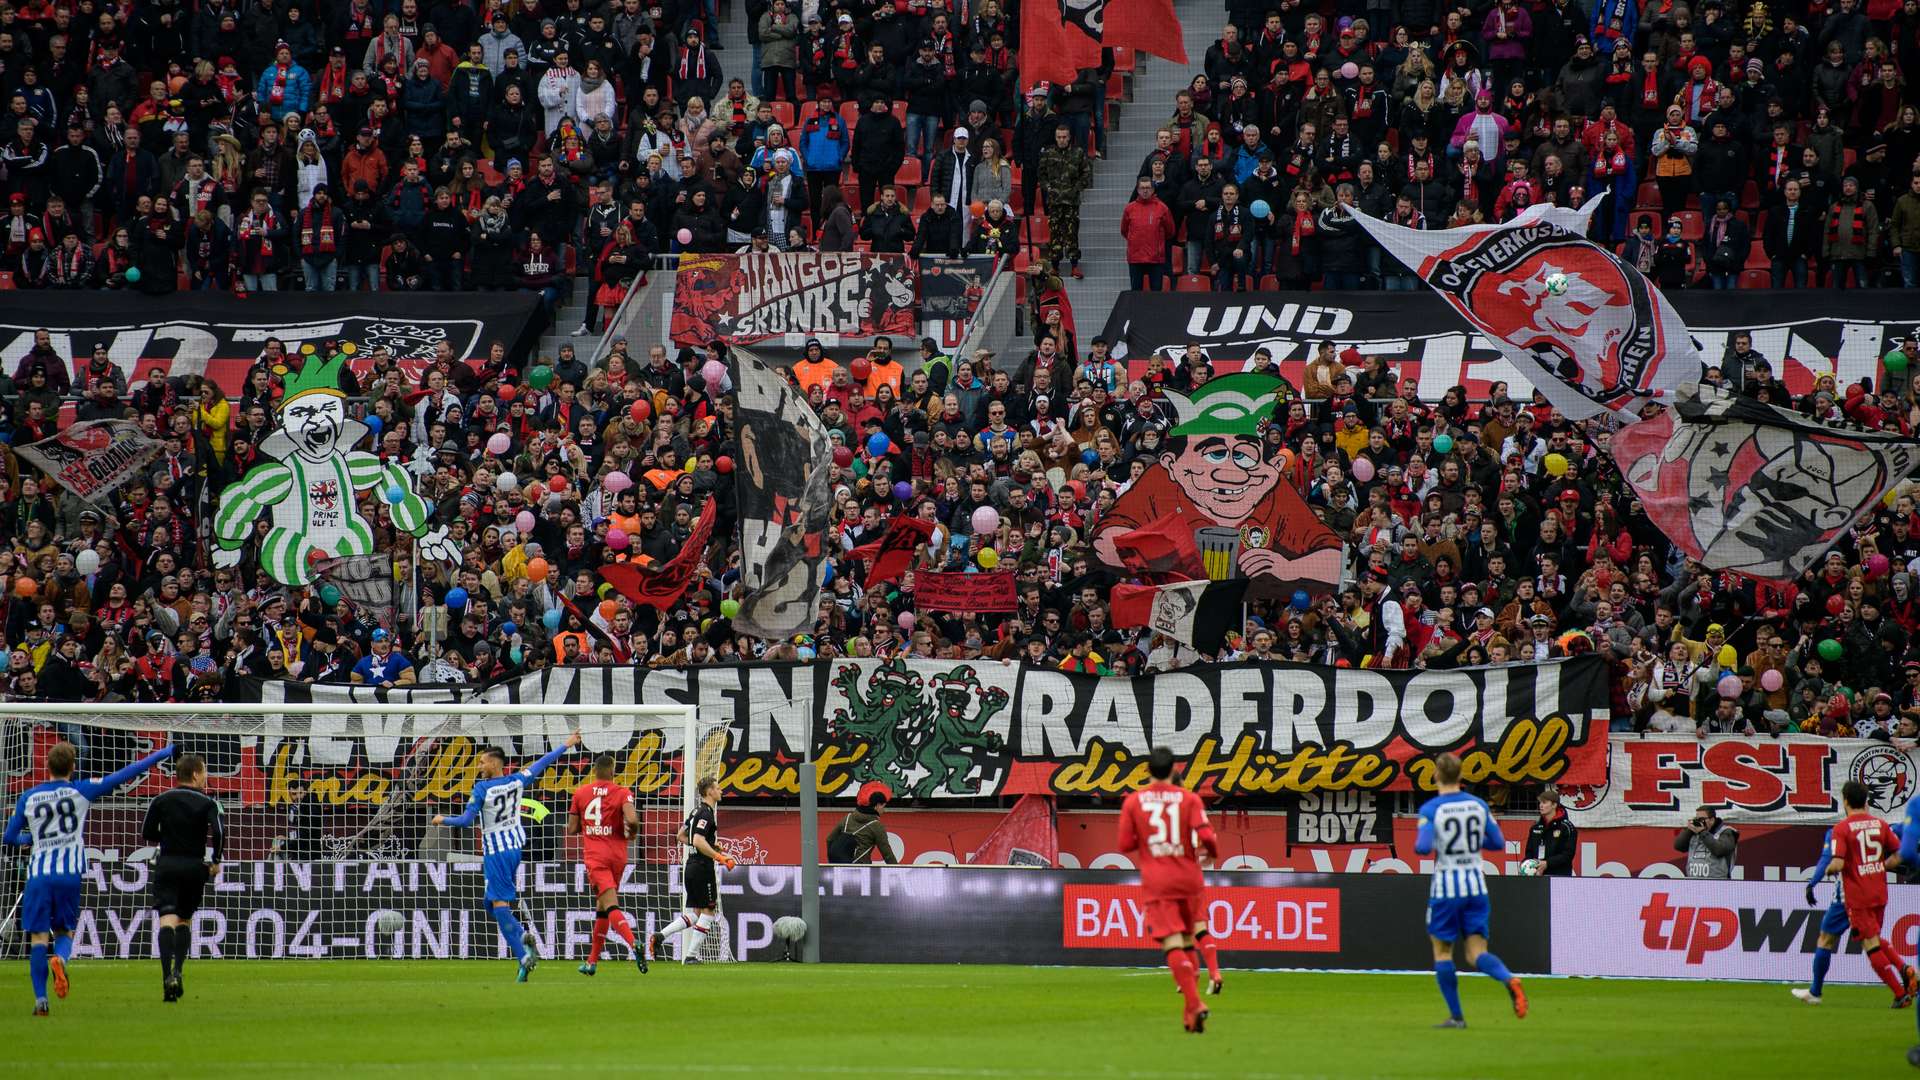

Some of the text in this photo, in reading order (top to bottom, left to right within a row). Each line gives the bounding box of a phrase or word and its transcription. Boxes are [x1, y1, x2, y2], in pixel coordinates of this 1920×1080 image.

[523, 262, 549, 274] BAYER
[1186, 303, 1353, 337] UND
[313, 511, 339, 519] PRINZ
[1182, 735, 1393, 792] Hütte
[1410, 717, 1566, 792] voll
[1623, 741, 1837, 811] FSI
[34, 797, 79, 840] 28
[493, 788, 519, 823] 27
[584, 797, 602, 826] 4
[1142, 802, 1181, 846] 31
[1298, 812, 1378, 843] BOYZ
[1444, 815, 1480, 855] 26
[1856, 829, 1883, 863] 15
[1689, 862, 1710, 877] FOTO
[1075, 897, 1329, 942] BAY04.DE
[1640, 893, 1866, 964] tipwi
